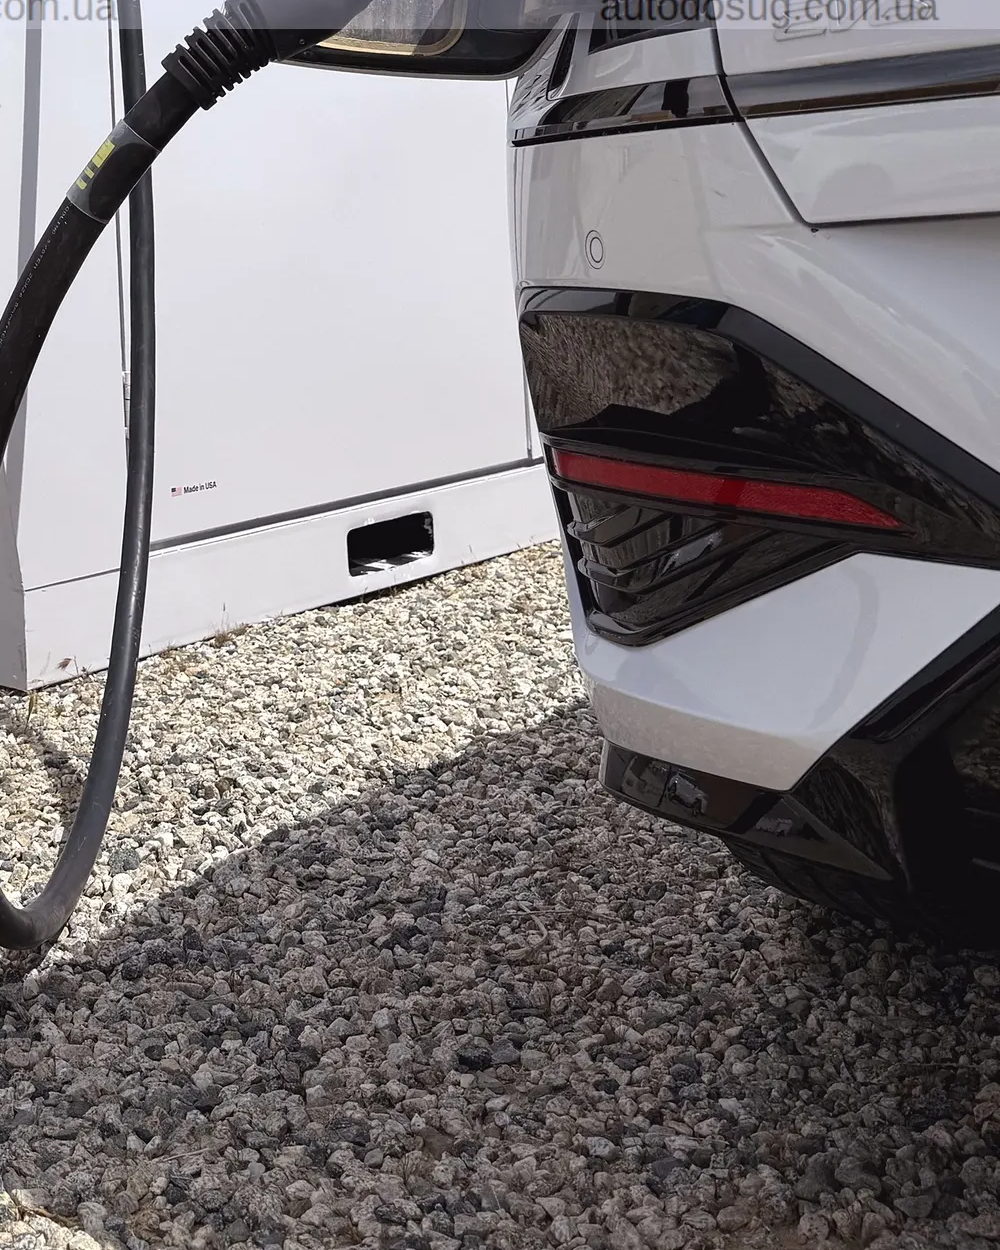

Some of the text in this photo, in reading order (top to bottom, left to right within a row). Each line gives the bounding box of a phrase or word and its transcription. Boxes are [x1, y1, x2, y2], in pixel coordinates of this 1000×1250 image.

[183, 481, 217, 494] Made in USA
